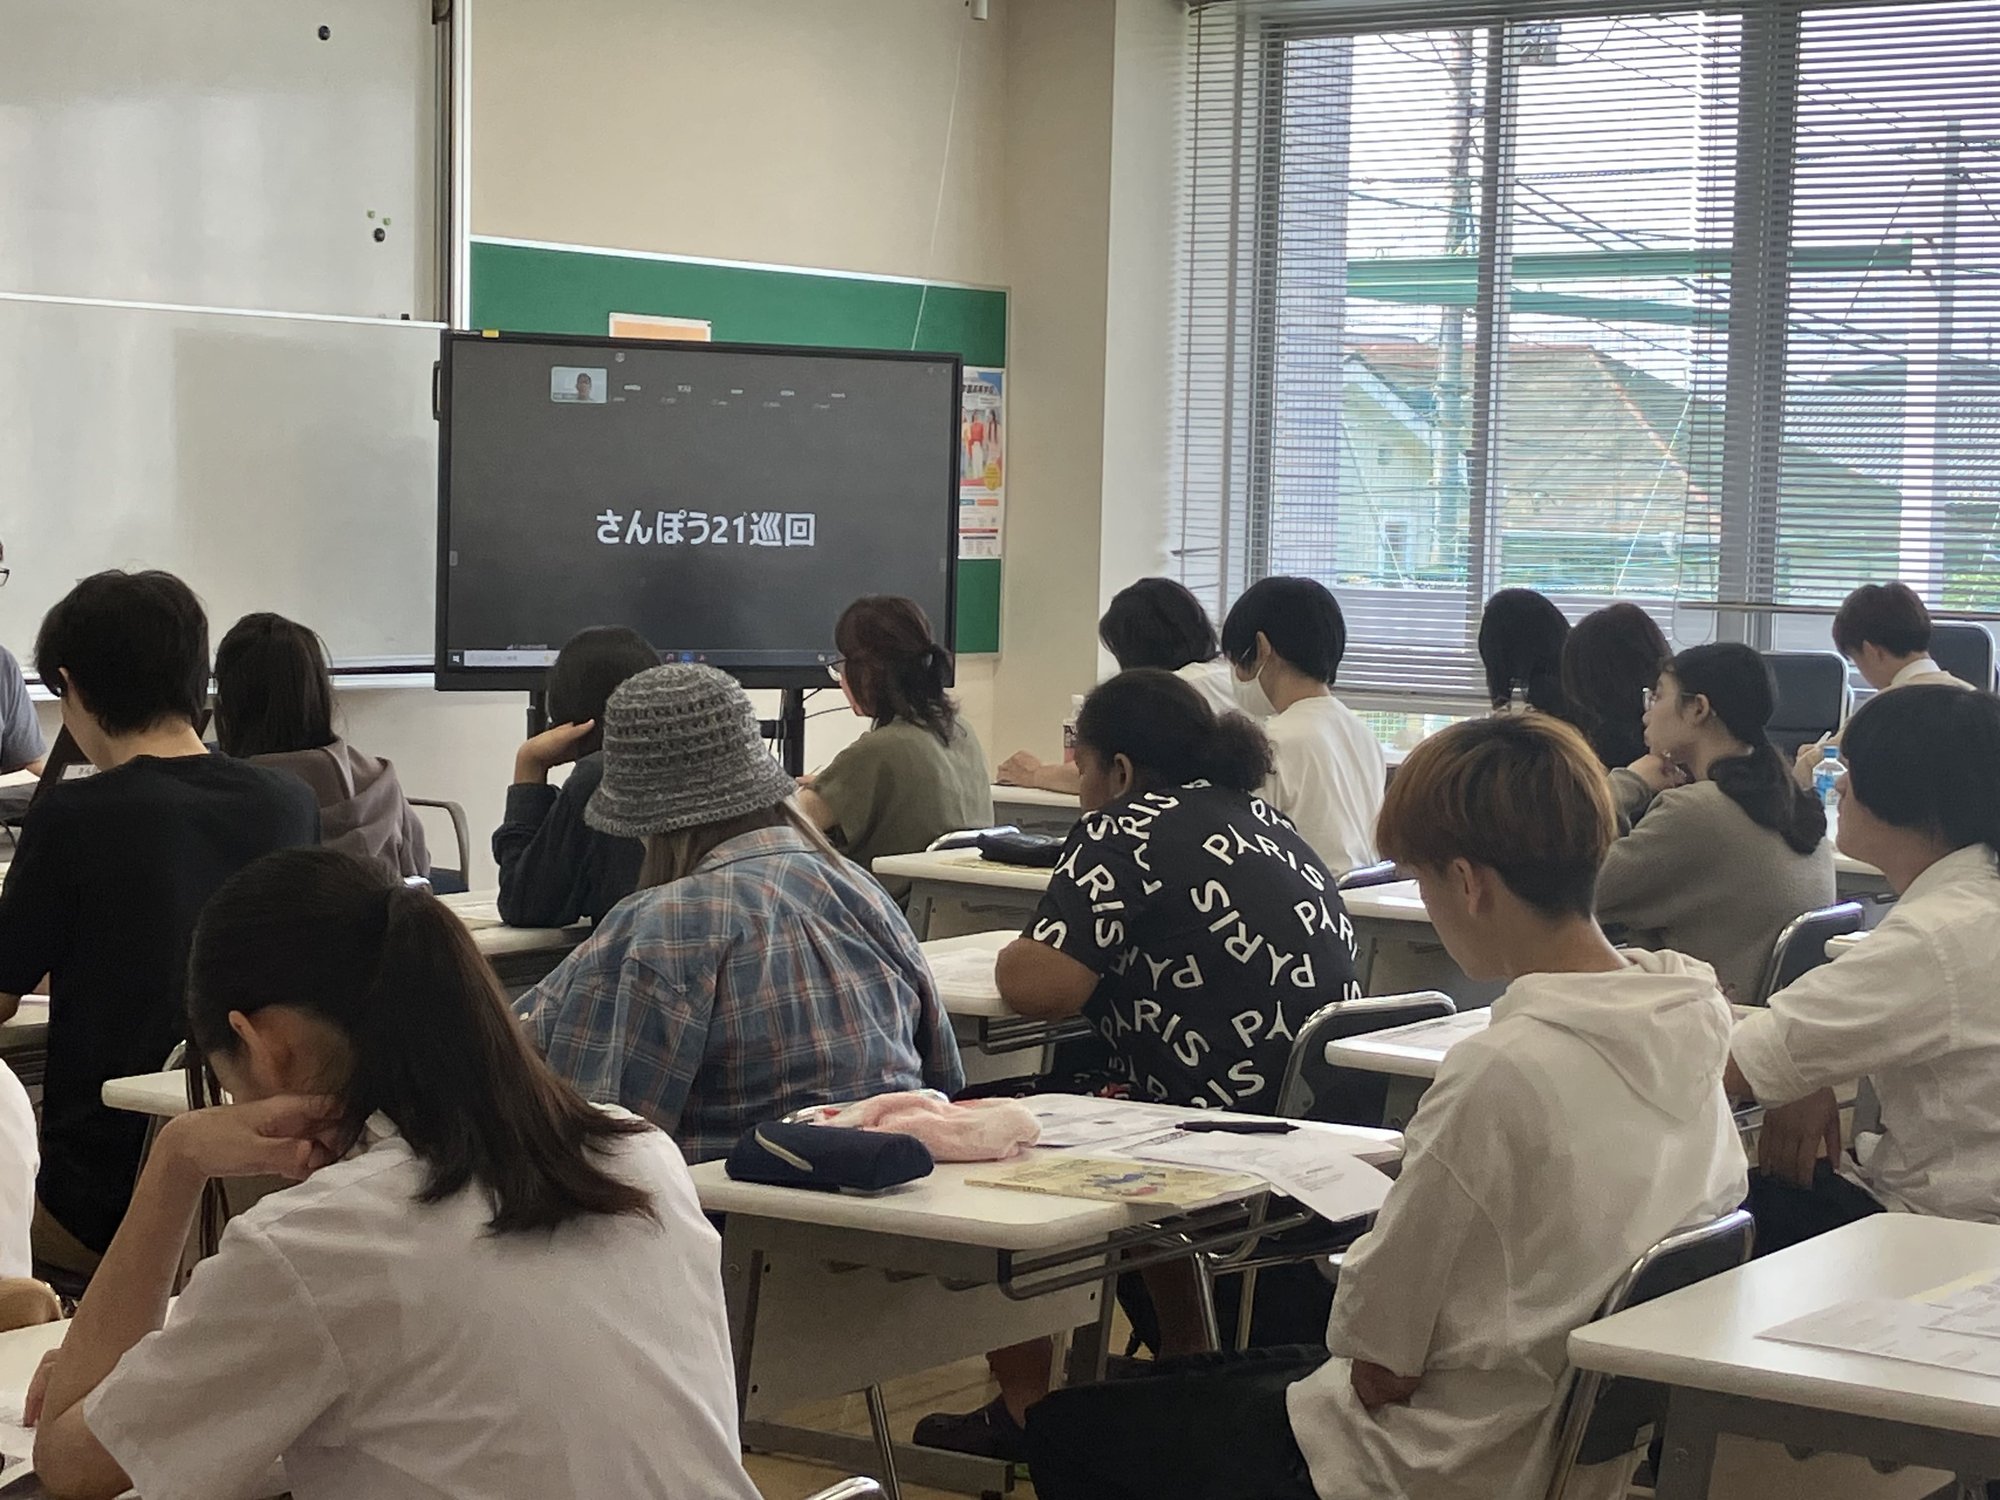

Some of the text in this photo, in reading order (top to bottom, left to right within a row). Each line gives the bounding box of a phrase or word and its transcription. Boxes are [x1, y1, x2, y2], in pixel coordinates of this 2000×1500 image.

[597, 509, 816, 547] さんぽう21巡回
[1202, 824, 1326, 892] PARIS
[1190, 879, 1316, 989] PARIS
[1101, 998, 1210, 1067] PARIS
